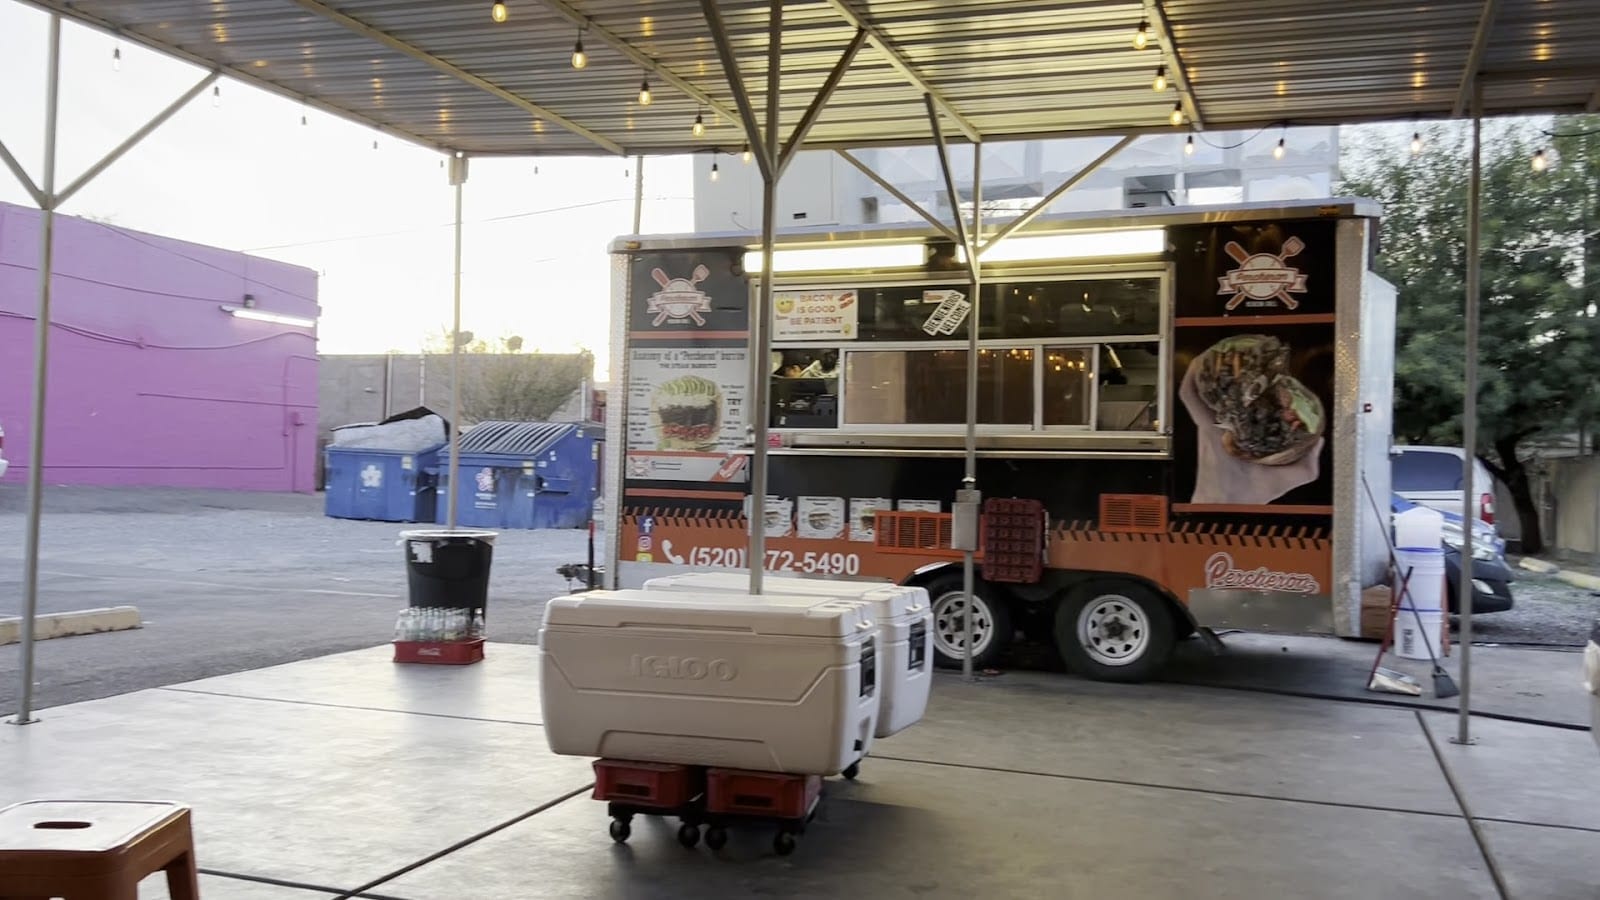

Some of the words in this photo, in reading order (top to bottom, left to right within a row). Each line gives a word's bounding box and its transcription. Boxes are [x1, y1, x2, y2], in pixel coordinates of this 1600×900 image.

[799, 293, 834, 302] BACON
[790, 317, 802, 326] BE
[803, 316, 843, 325] PATIENT
[796, 306, 806, 314] IS
[807, 305, 836, 313] GOOD
[940, 304, 969, 332] WELCOME
[689, 546, 746, 569] (520)
[1205, 552, 1321, 594] Percheron
[629, 653, 740, 682] IGLOO
